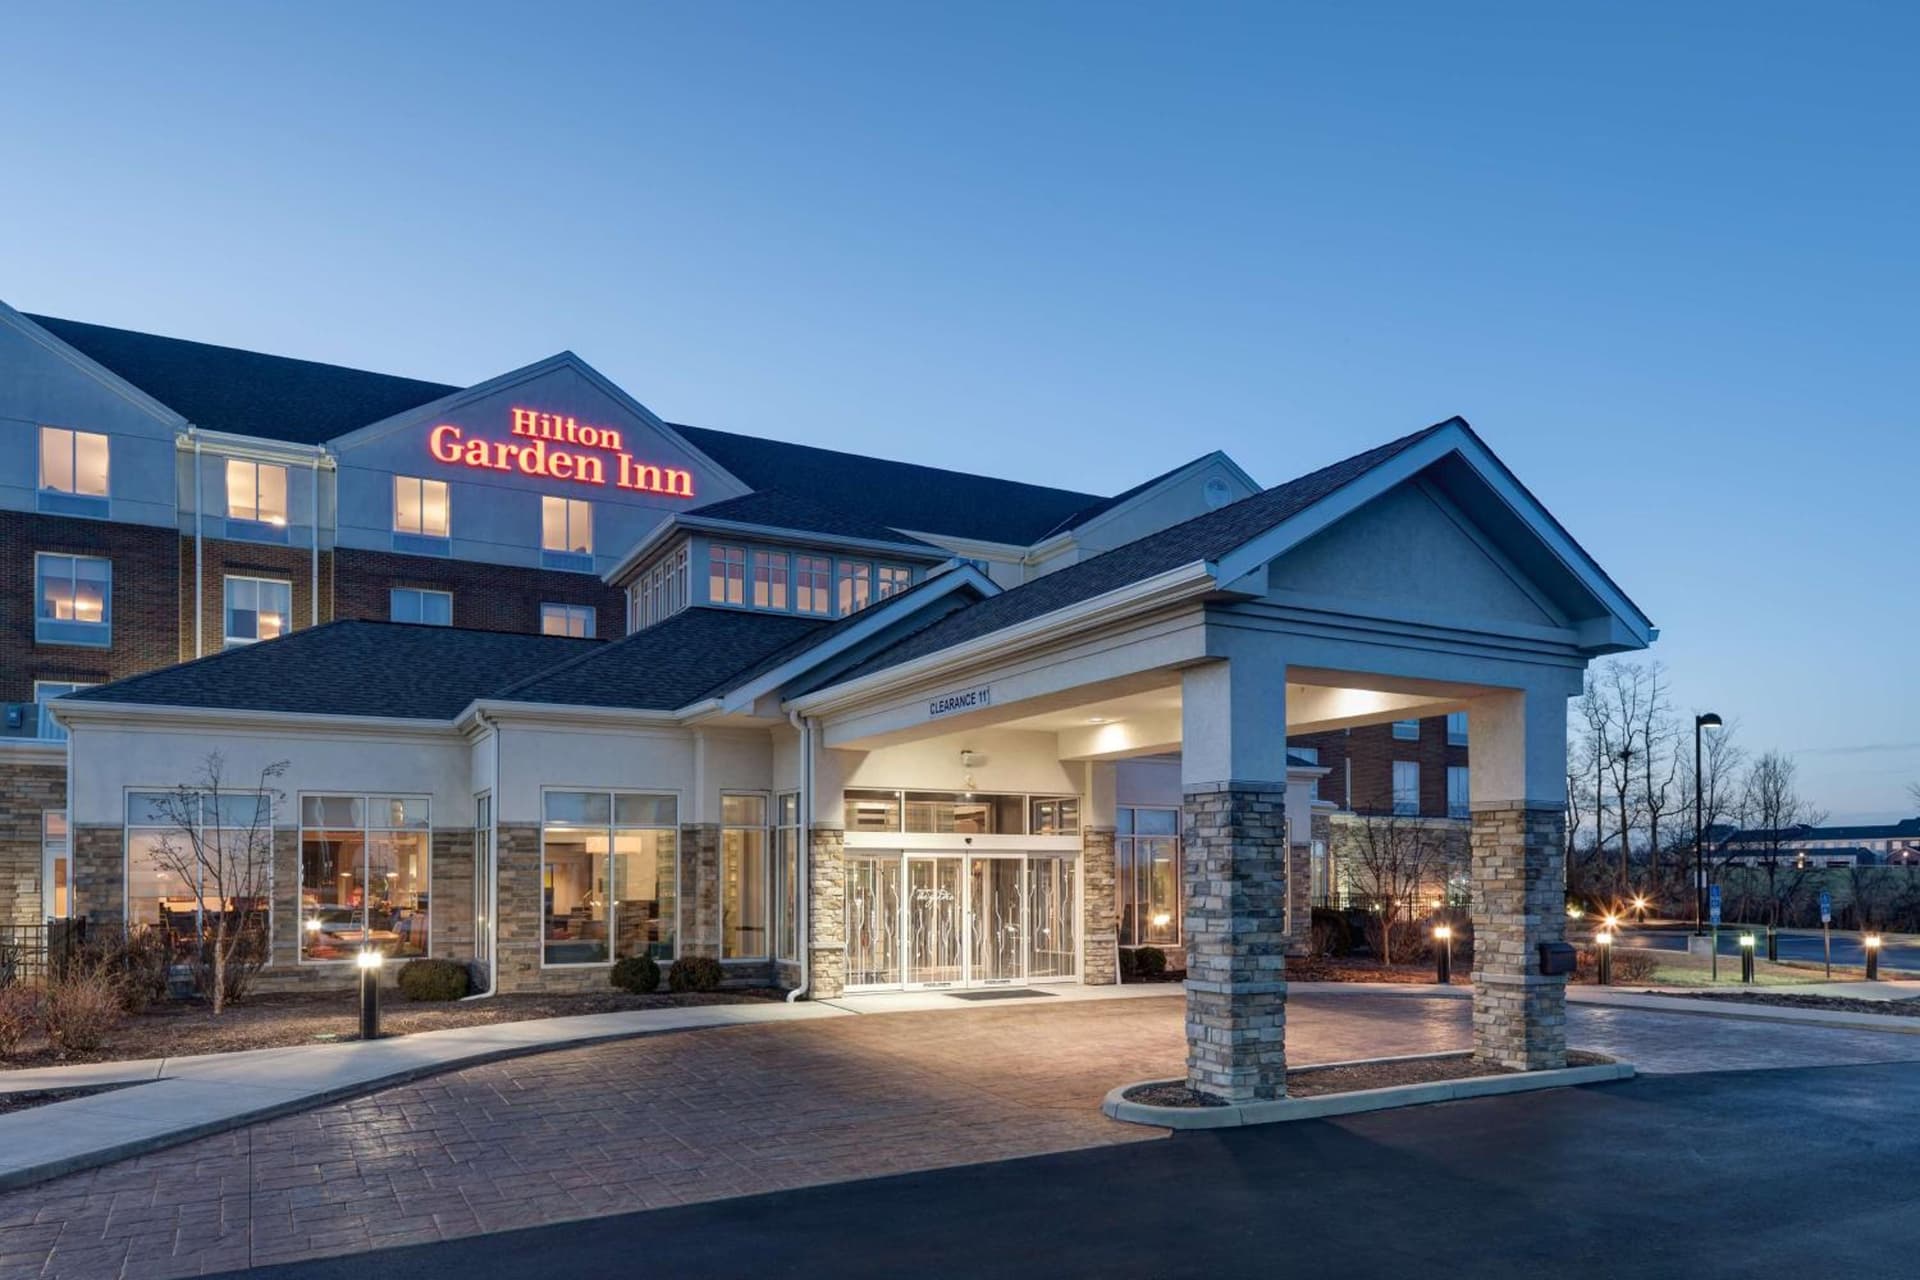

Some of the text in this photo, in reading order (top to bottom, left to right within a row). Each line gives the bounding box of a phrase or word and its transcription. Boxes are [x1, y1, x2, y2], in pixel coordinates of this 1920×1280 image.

[511, 407, 622, 450] Hilton
[429, 425, 694, 496] Garden Inn
[930, 692, 976, 715] CLEARANCE
